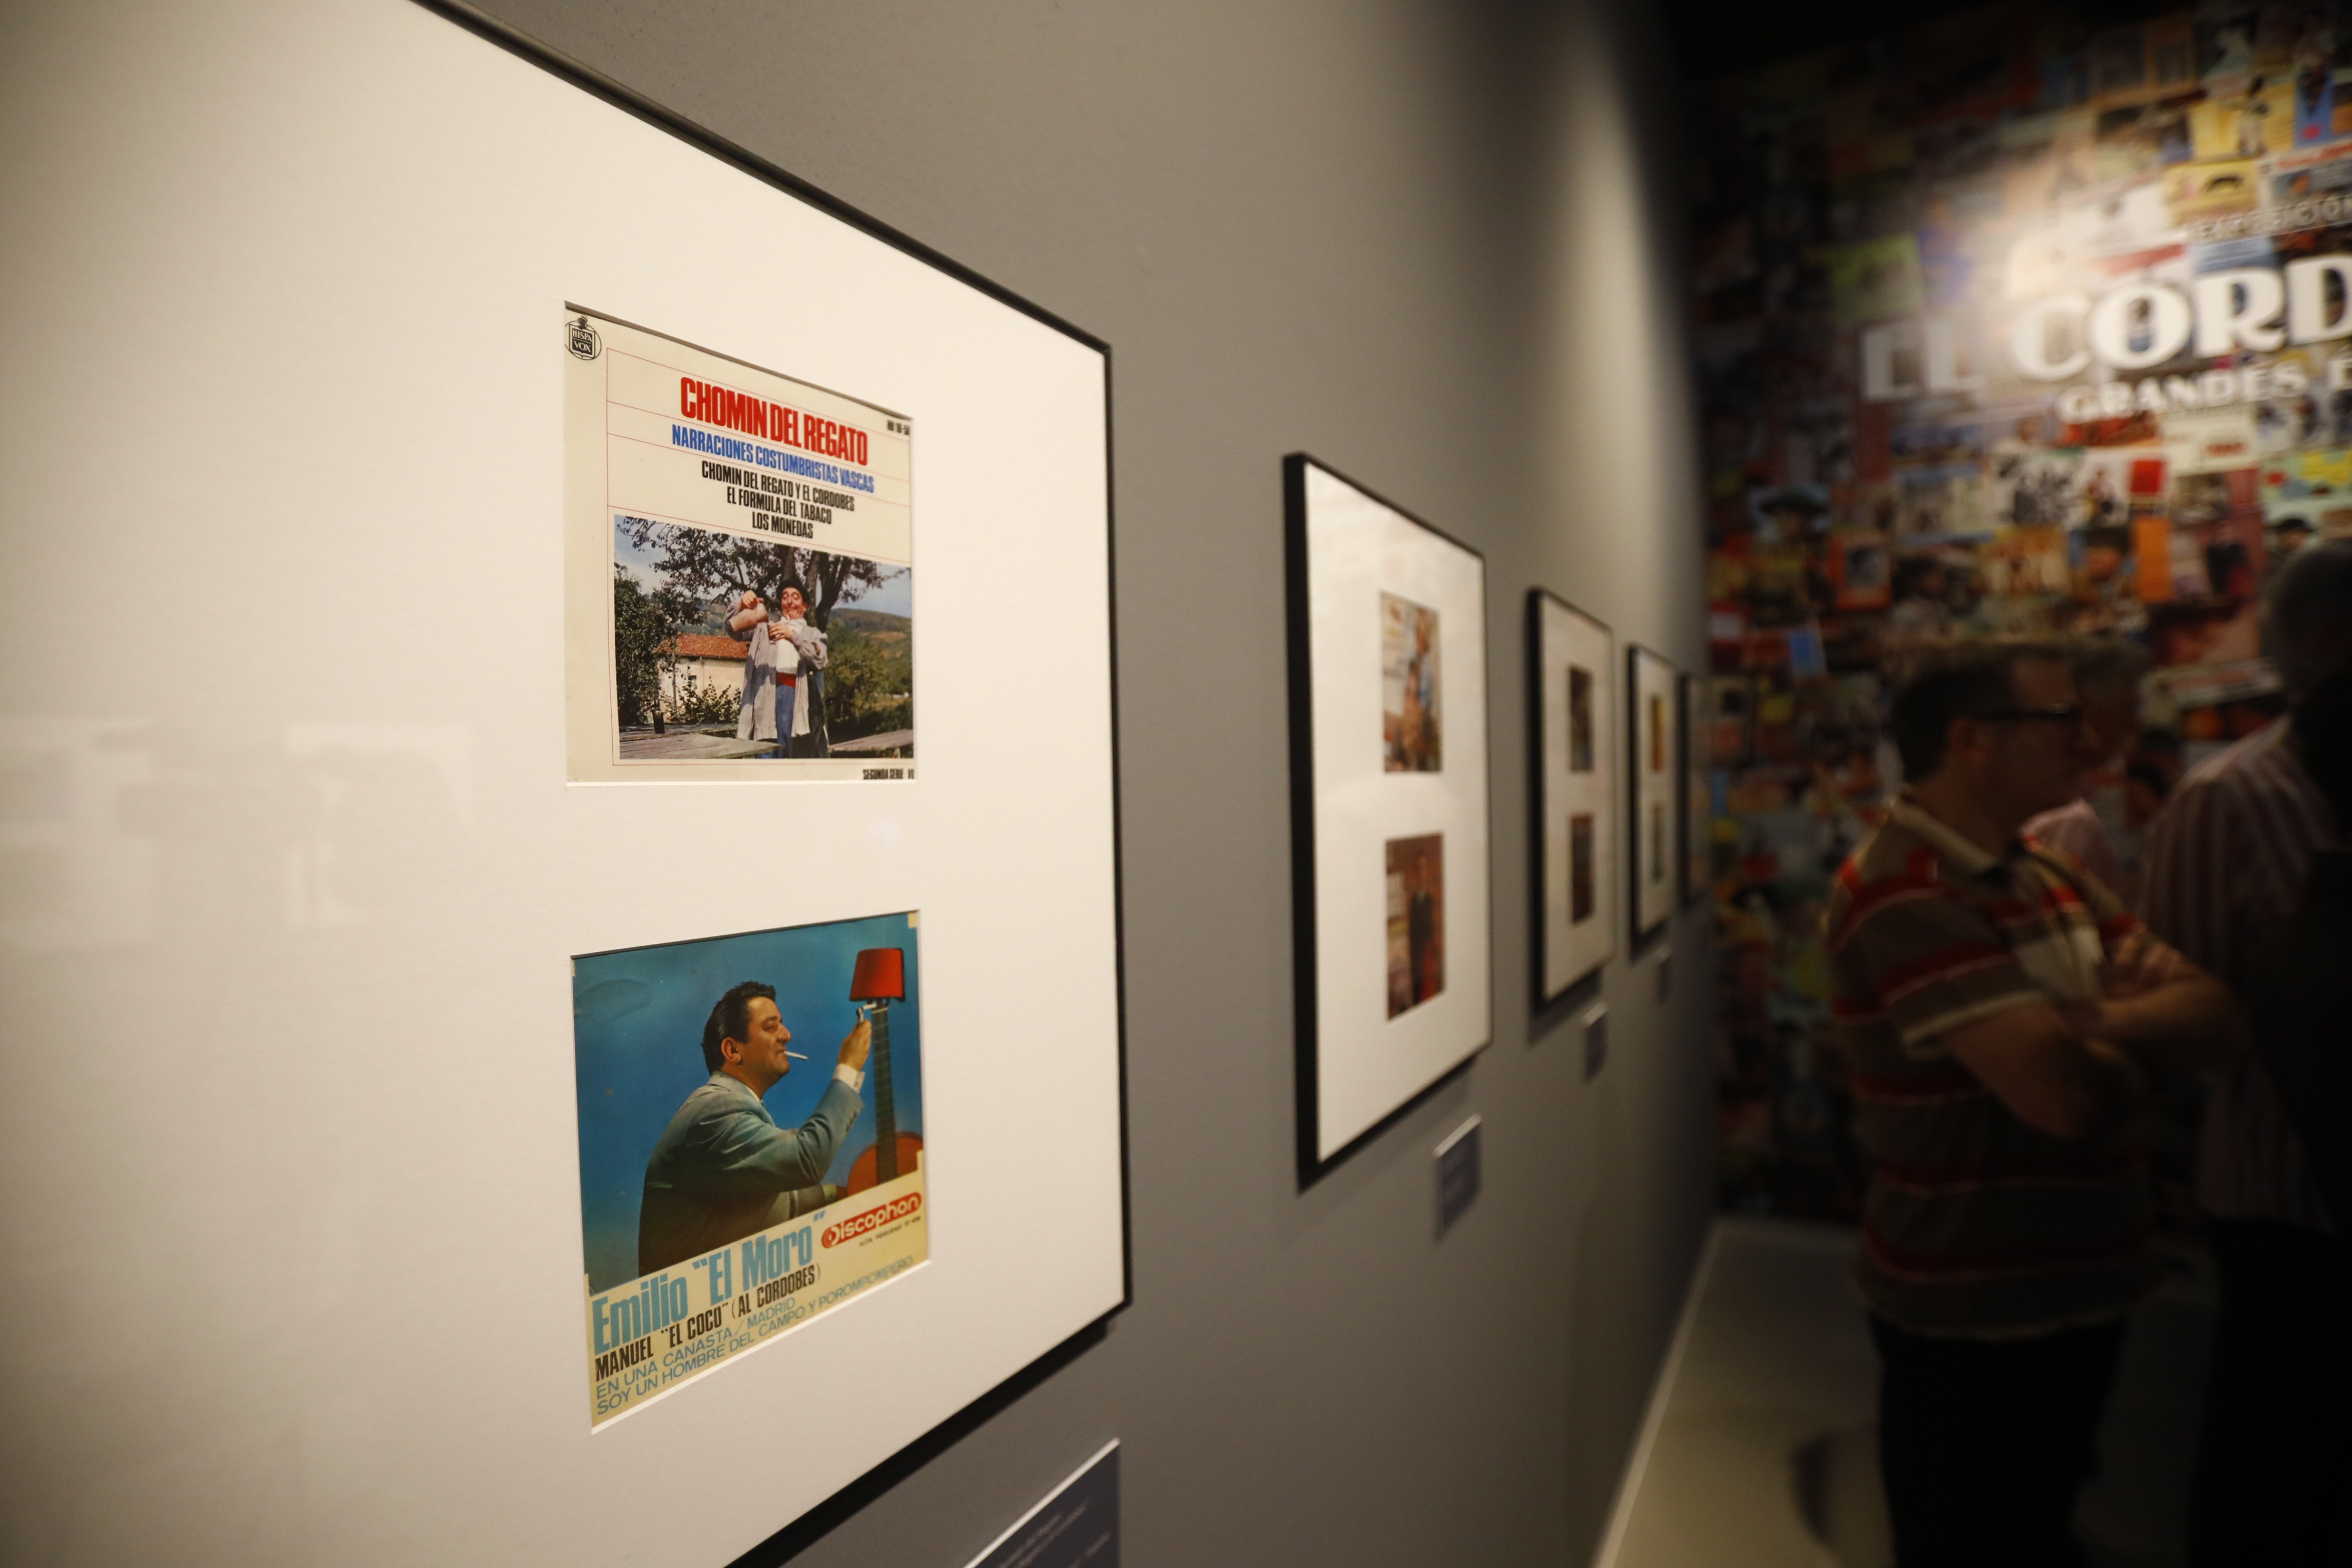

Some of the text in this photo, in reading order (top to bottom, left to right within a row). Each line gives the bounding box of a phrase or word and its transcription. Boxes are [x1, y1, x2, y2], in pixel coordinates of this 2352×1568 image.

[572, 329, 592, 342] HISPA
[573, 340, 591, 352] VOX
[681, 377, 868, 466] CHOMIN DEL REGATO
[2056, 359, 2310, 423] GRANDES
[672, 424, 875, 493] NARRACIONES COSTUMBRISTAS VASCAS
[702, 460, 855, 511] CHOMIN DEL REGATO Y EL CORDOBES
[727, 486, 831, 524] EL FORMULA DEL TABACO
[752, 511, 813, 538] LOS MONEDAS
[823, 1196, 920, 1247] Discophon
[592, 1273, 688, 1356] Emilio
[595, 1262, 821, 1382] MANUEL "EL COCO" (AL CORDOBES)
[596, 1377, 619, 1399] EN
[624, 1360, 658, 1386] UNA
[663, 1326, 732, 1367] CANASTA
[747, 1297, 796, 1329] MADRID
[597, 1387, 631, 1415] SOY
[636, 1375, 658, 1396] UN
[662, 1344, 726, 1385] HOMBRE
[729, 1332, 755, 1353] DEL
[759, 1306, 805, 1337] CAMPO
[808, 1300, 817, 1312] Y
